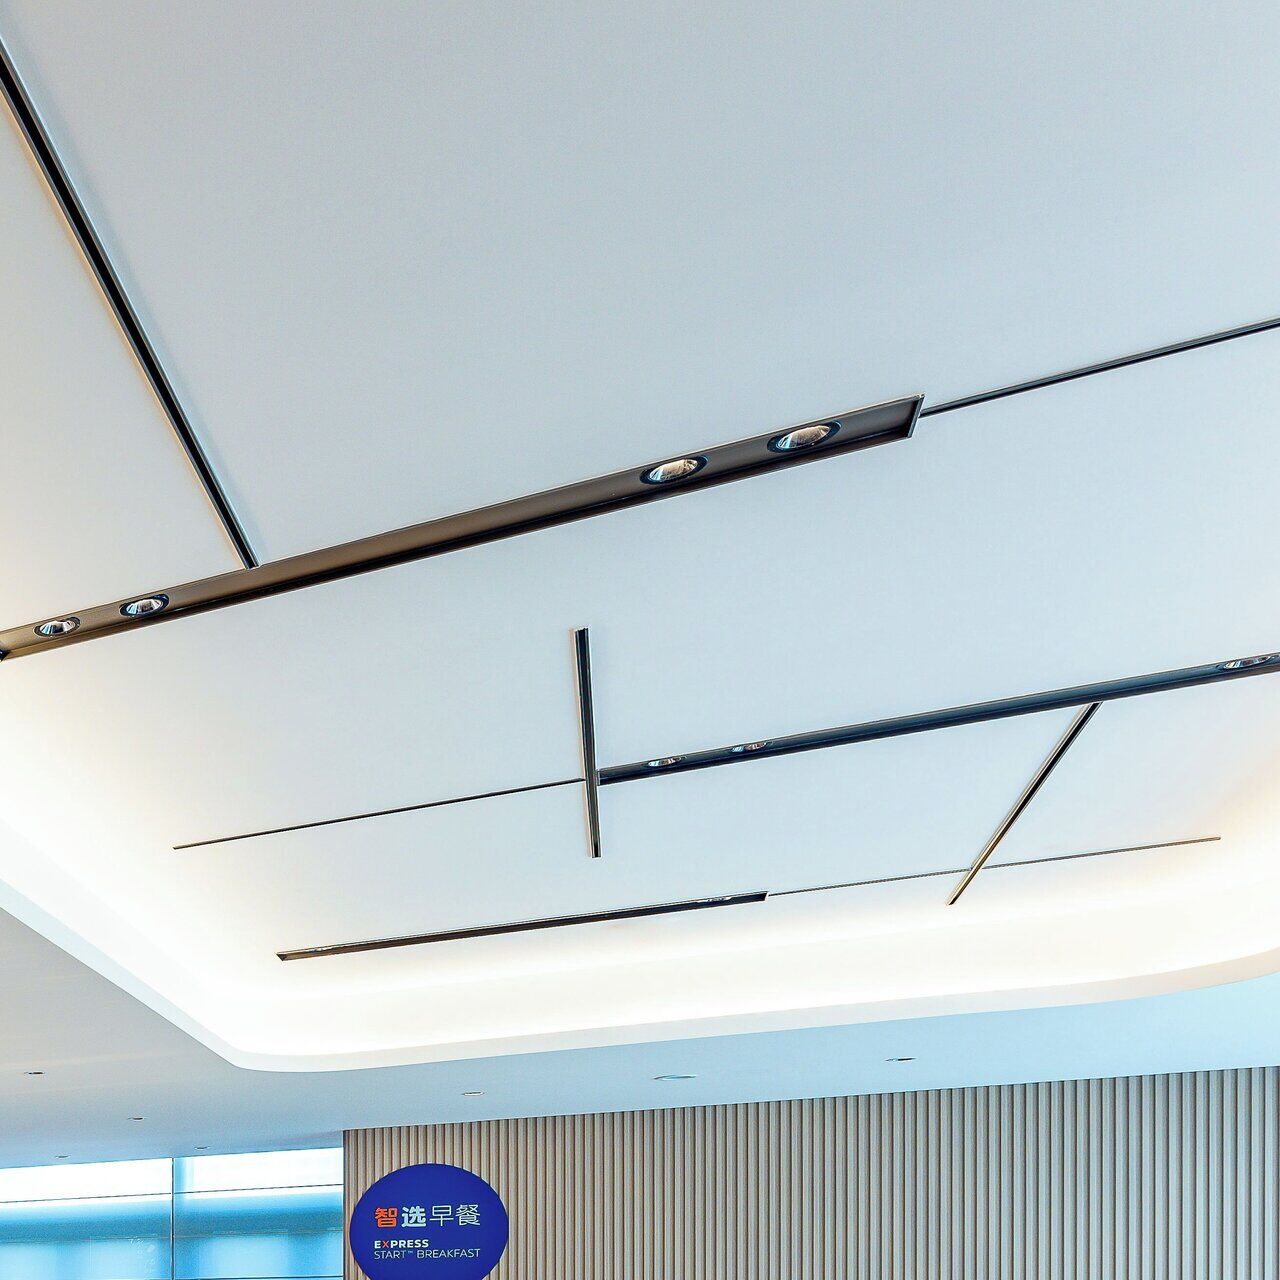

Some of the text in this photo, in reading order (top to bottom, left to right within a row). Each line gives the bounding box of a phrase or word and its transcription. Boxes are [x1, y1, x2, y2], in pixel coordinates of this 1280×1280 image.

[374, 1204, 481, 1228] 智选早餐
[374, 1239, 429, 1249] EXPRESS
[416, 1248, 481, 1259] BREAKFAST
